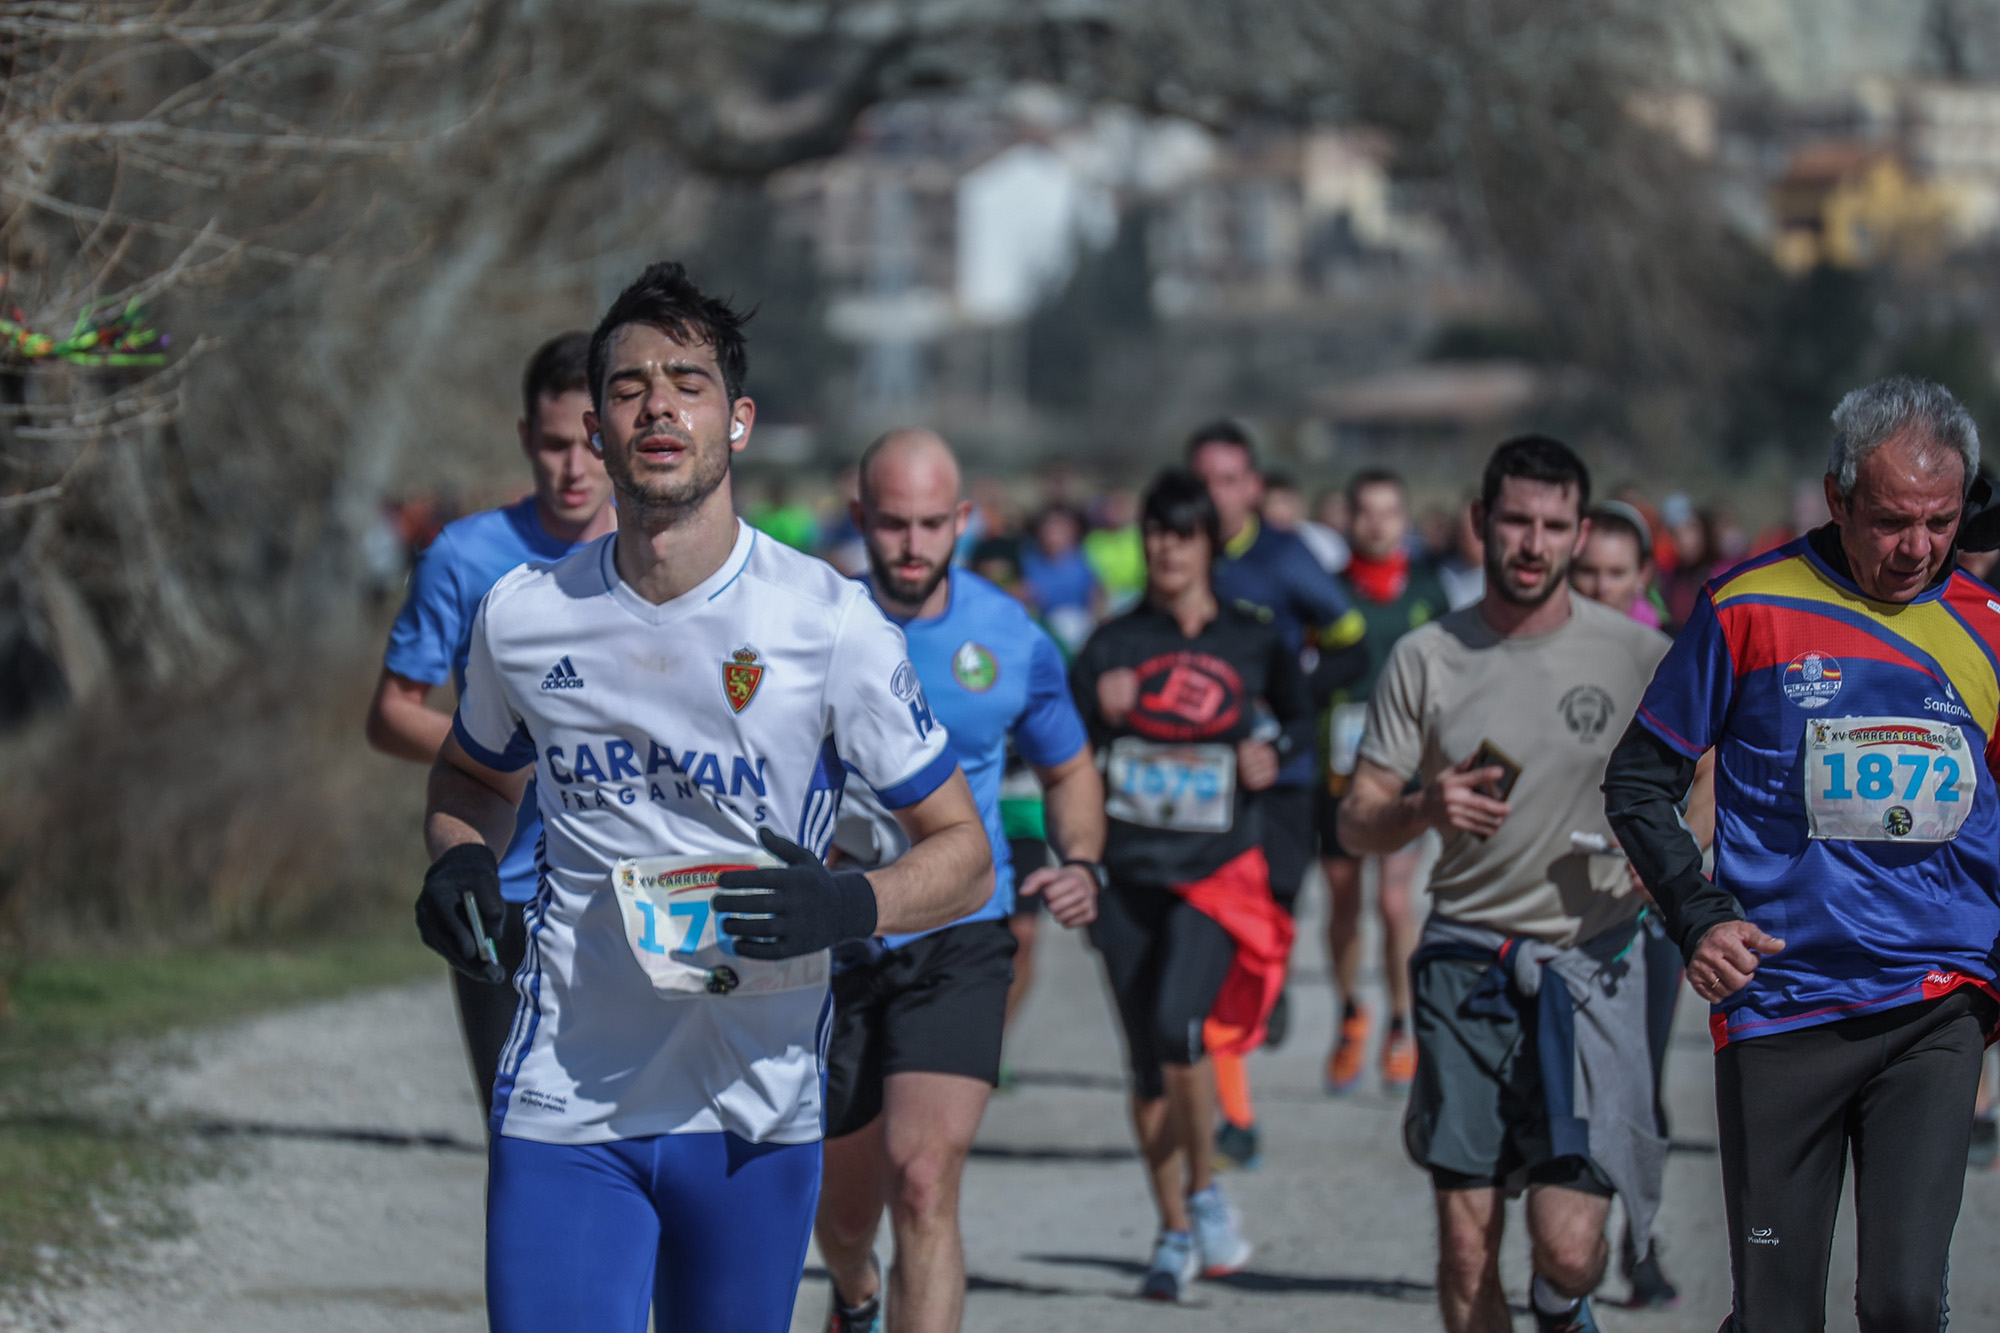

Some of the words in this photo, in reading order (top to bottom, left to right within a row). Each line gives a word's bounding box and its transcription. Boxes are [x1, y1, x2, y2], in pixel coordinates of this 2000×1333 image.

[541, 676, 584, 690] adidas
[1831, 731, 1846, 741] XV
[1848, 731, 1899, 741] CARRERA
[1902, 731, 1920, 741] DEL
[1921, 733, 1945, 743] EBRO
[545, 739, 766, 797] CARAVAN
[1823, 753, 1960, 802] 1872
[658, 871, 716, 888] CARRERA
